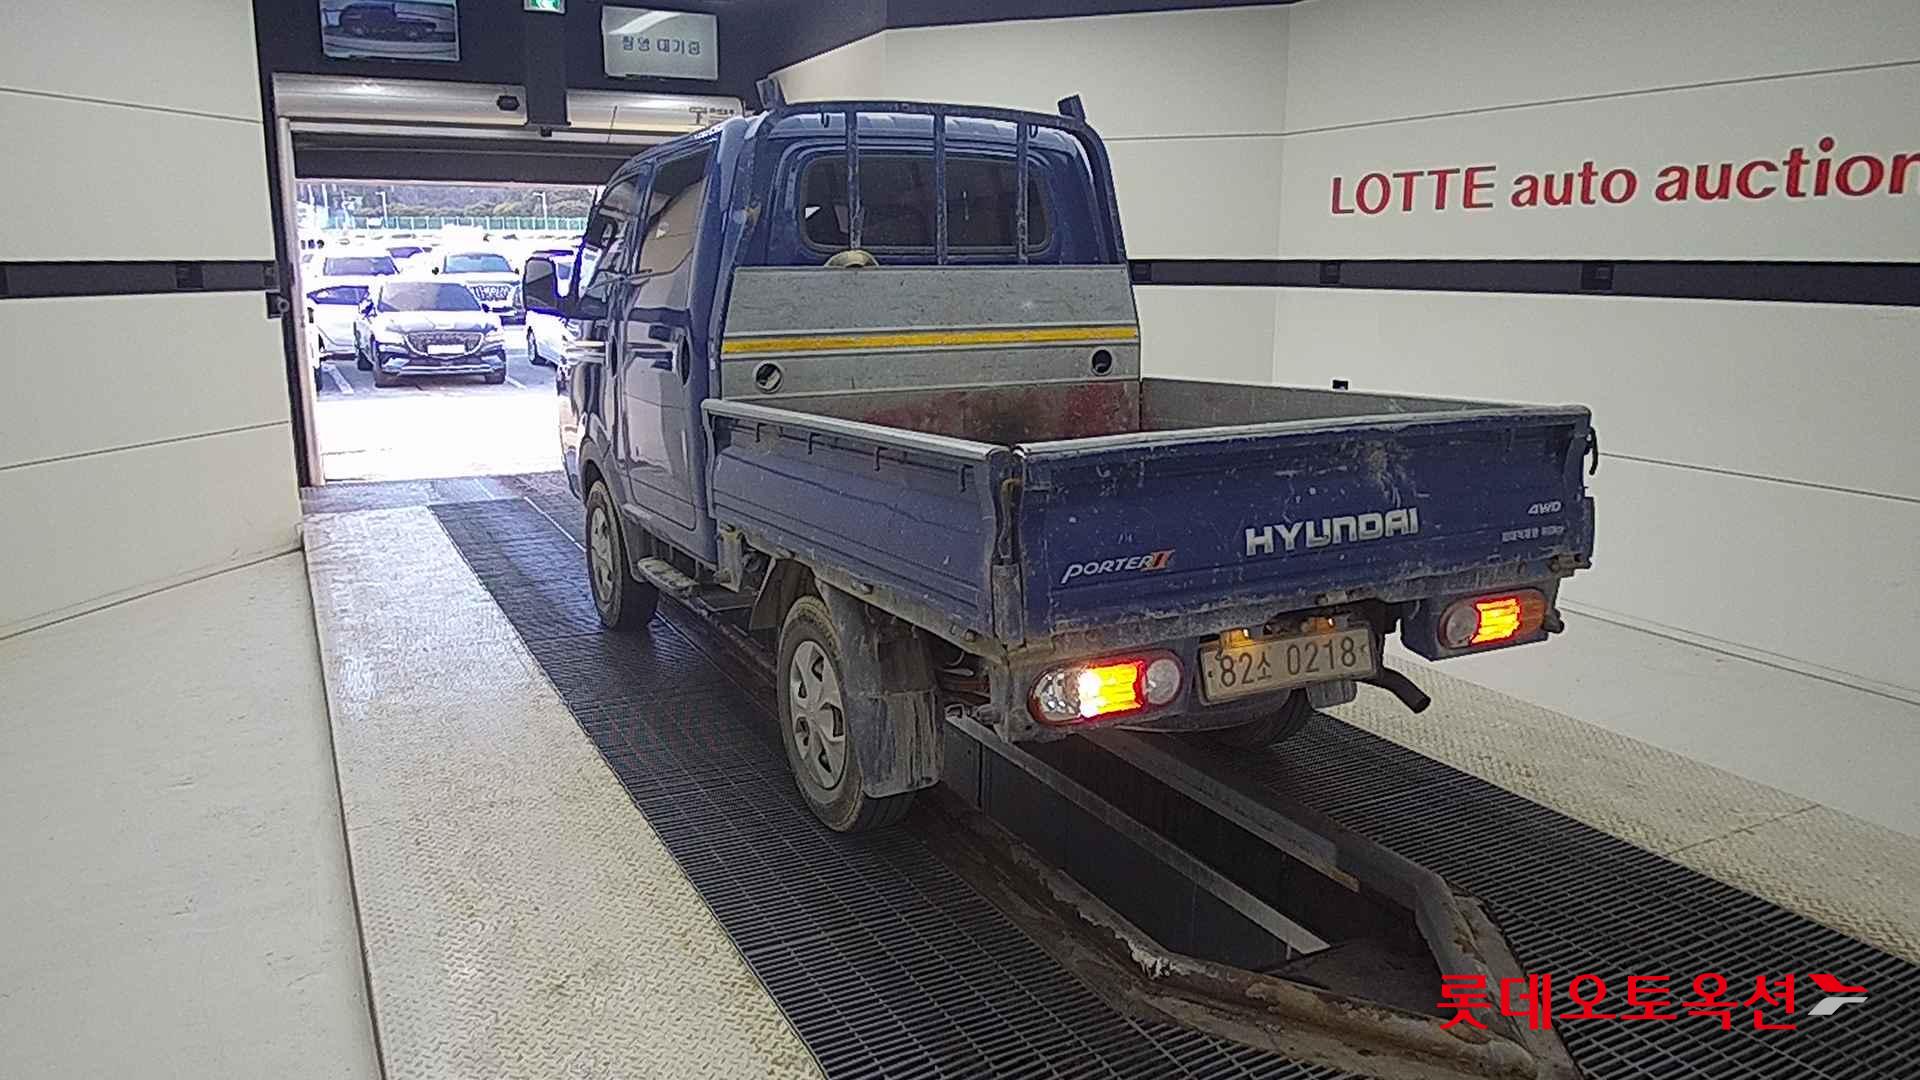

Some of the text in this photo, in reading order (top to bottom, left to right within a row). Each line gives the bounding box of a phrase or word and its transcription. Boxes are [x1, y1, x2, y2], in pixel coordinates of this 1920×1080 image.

[1331, 164, 1496, 215] LOTTE
[1509, 160, 1638, 208] auto
[1245, 507, 1419, 557] HYUNDAI
[1527, 500, 1562, 515] 4WD
[1219, 635, 1357, 688] 82소 0218
